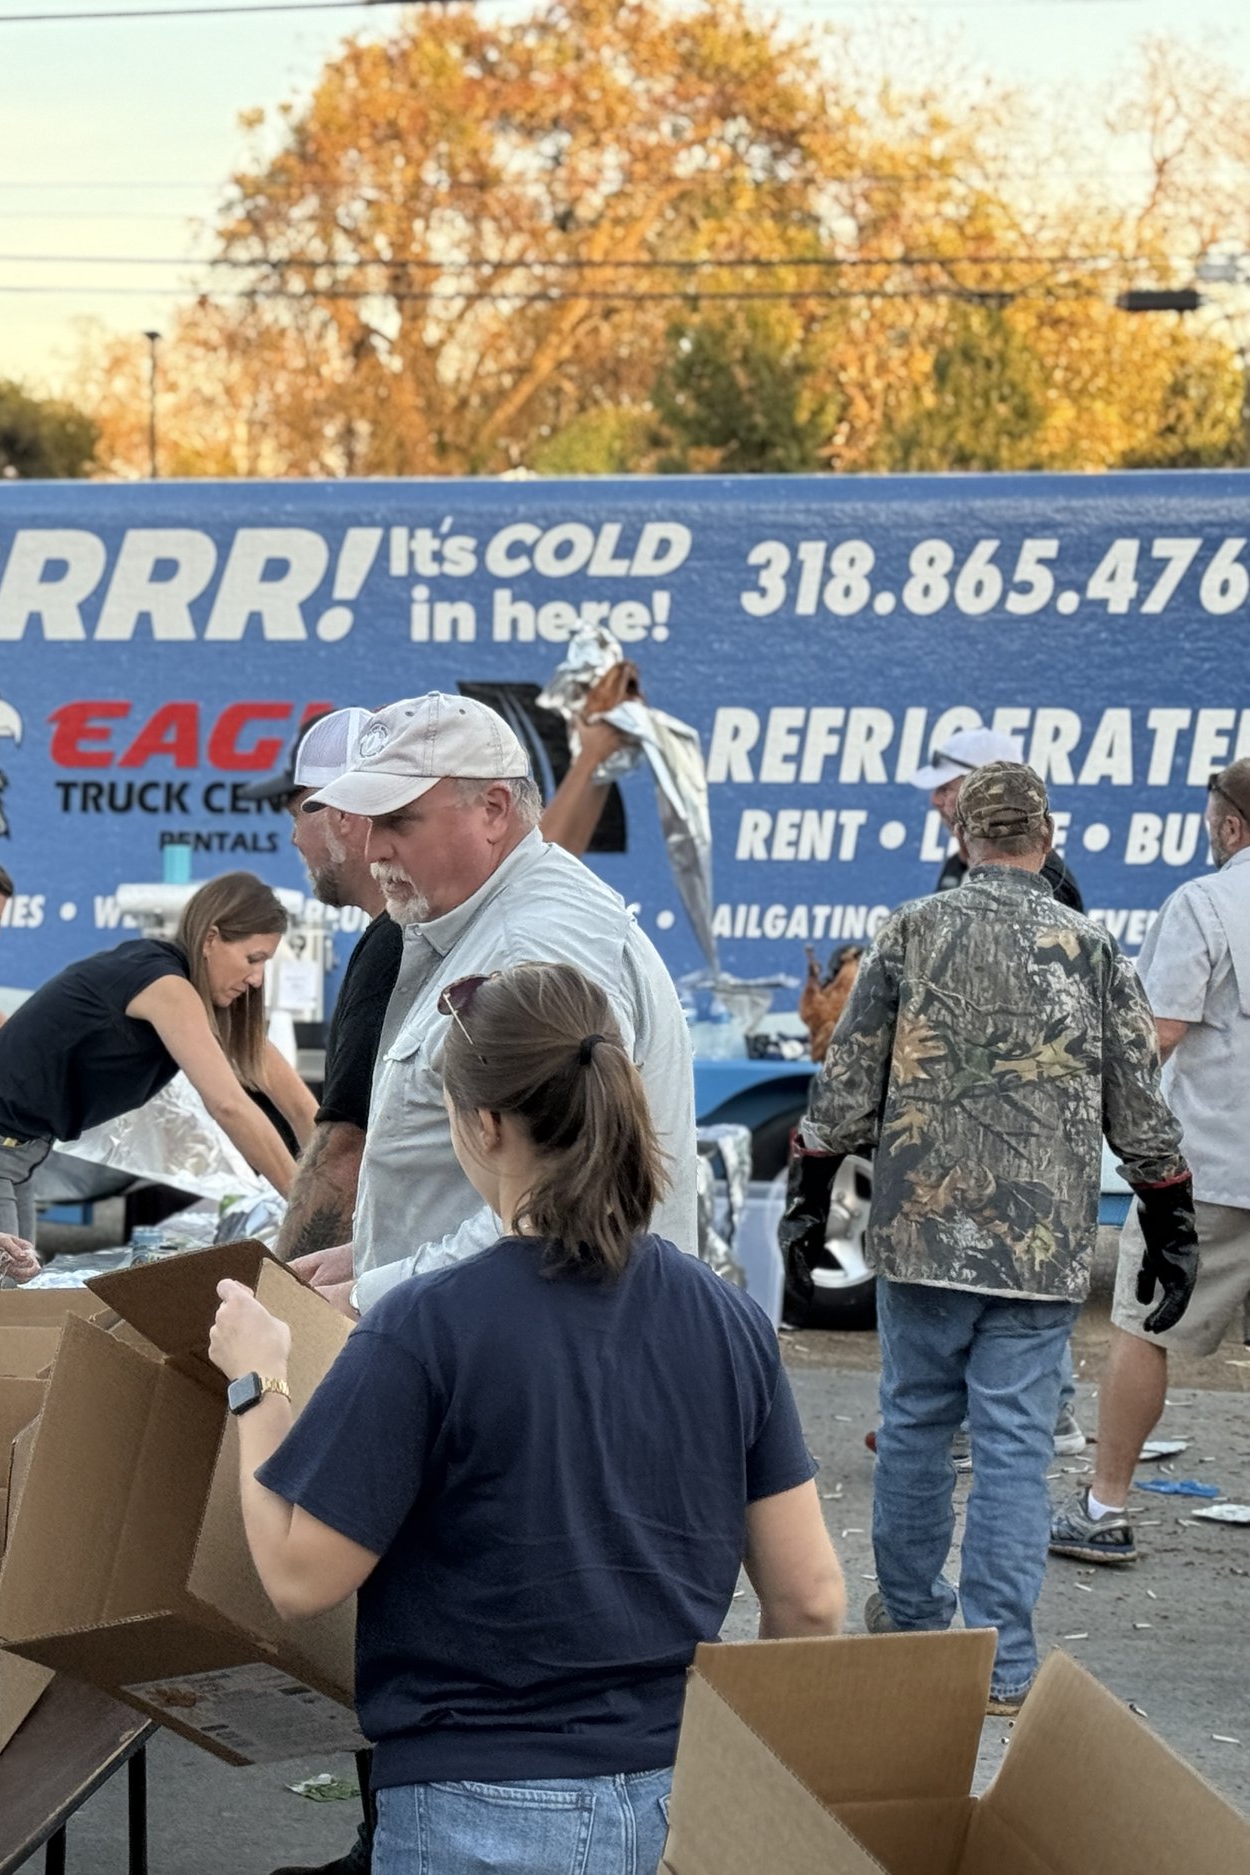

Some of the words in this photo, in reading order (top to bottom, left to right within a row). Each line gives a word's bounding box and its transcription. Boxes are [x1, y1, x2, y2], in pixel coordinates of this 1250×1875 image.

[389, 516, 478, 577] It's
[485, 522, 692, 578] COLD
[740, 538, 1250, 616] 318.865.476
[411, 584, 476, 642] in
[493, 588, 671, 642] here!
[47, 700, 335, 771] EAG
[55, 782, 191, 813] TRUCK
[203, 782, 286, 813] CEN
[158, 831, 280, 852] RENTALS
[735, 810, 867, 861] RENT
[1124, 812, 1223, 865] BU
[711, 904, 893, 939] AILGATING
